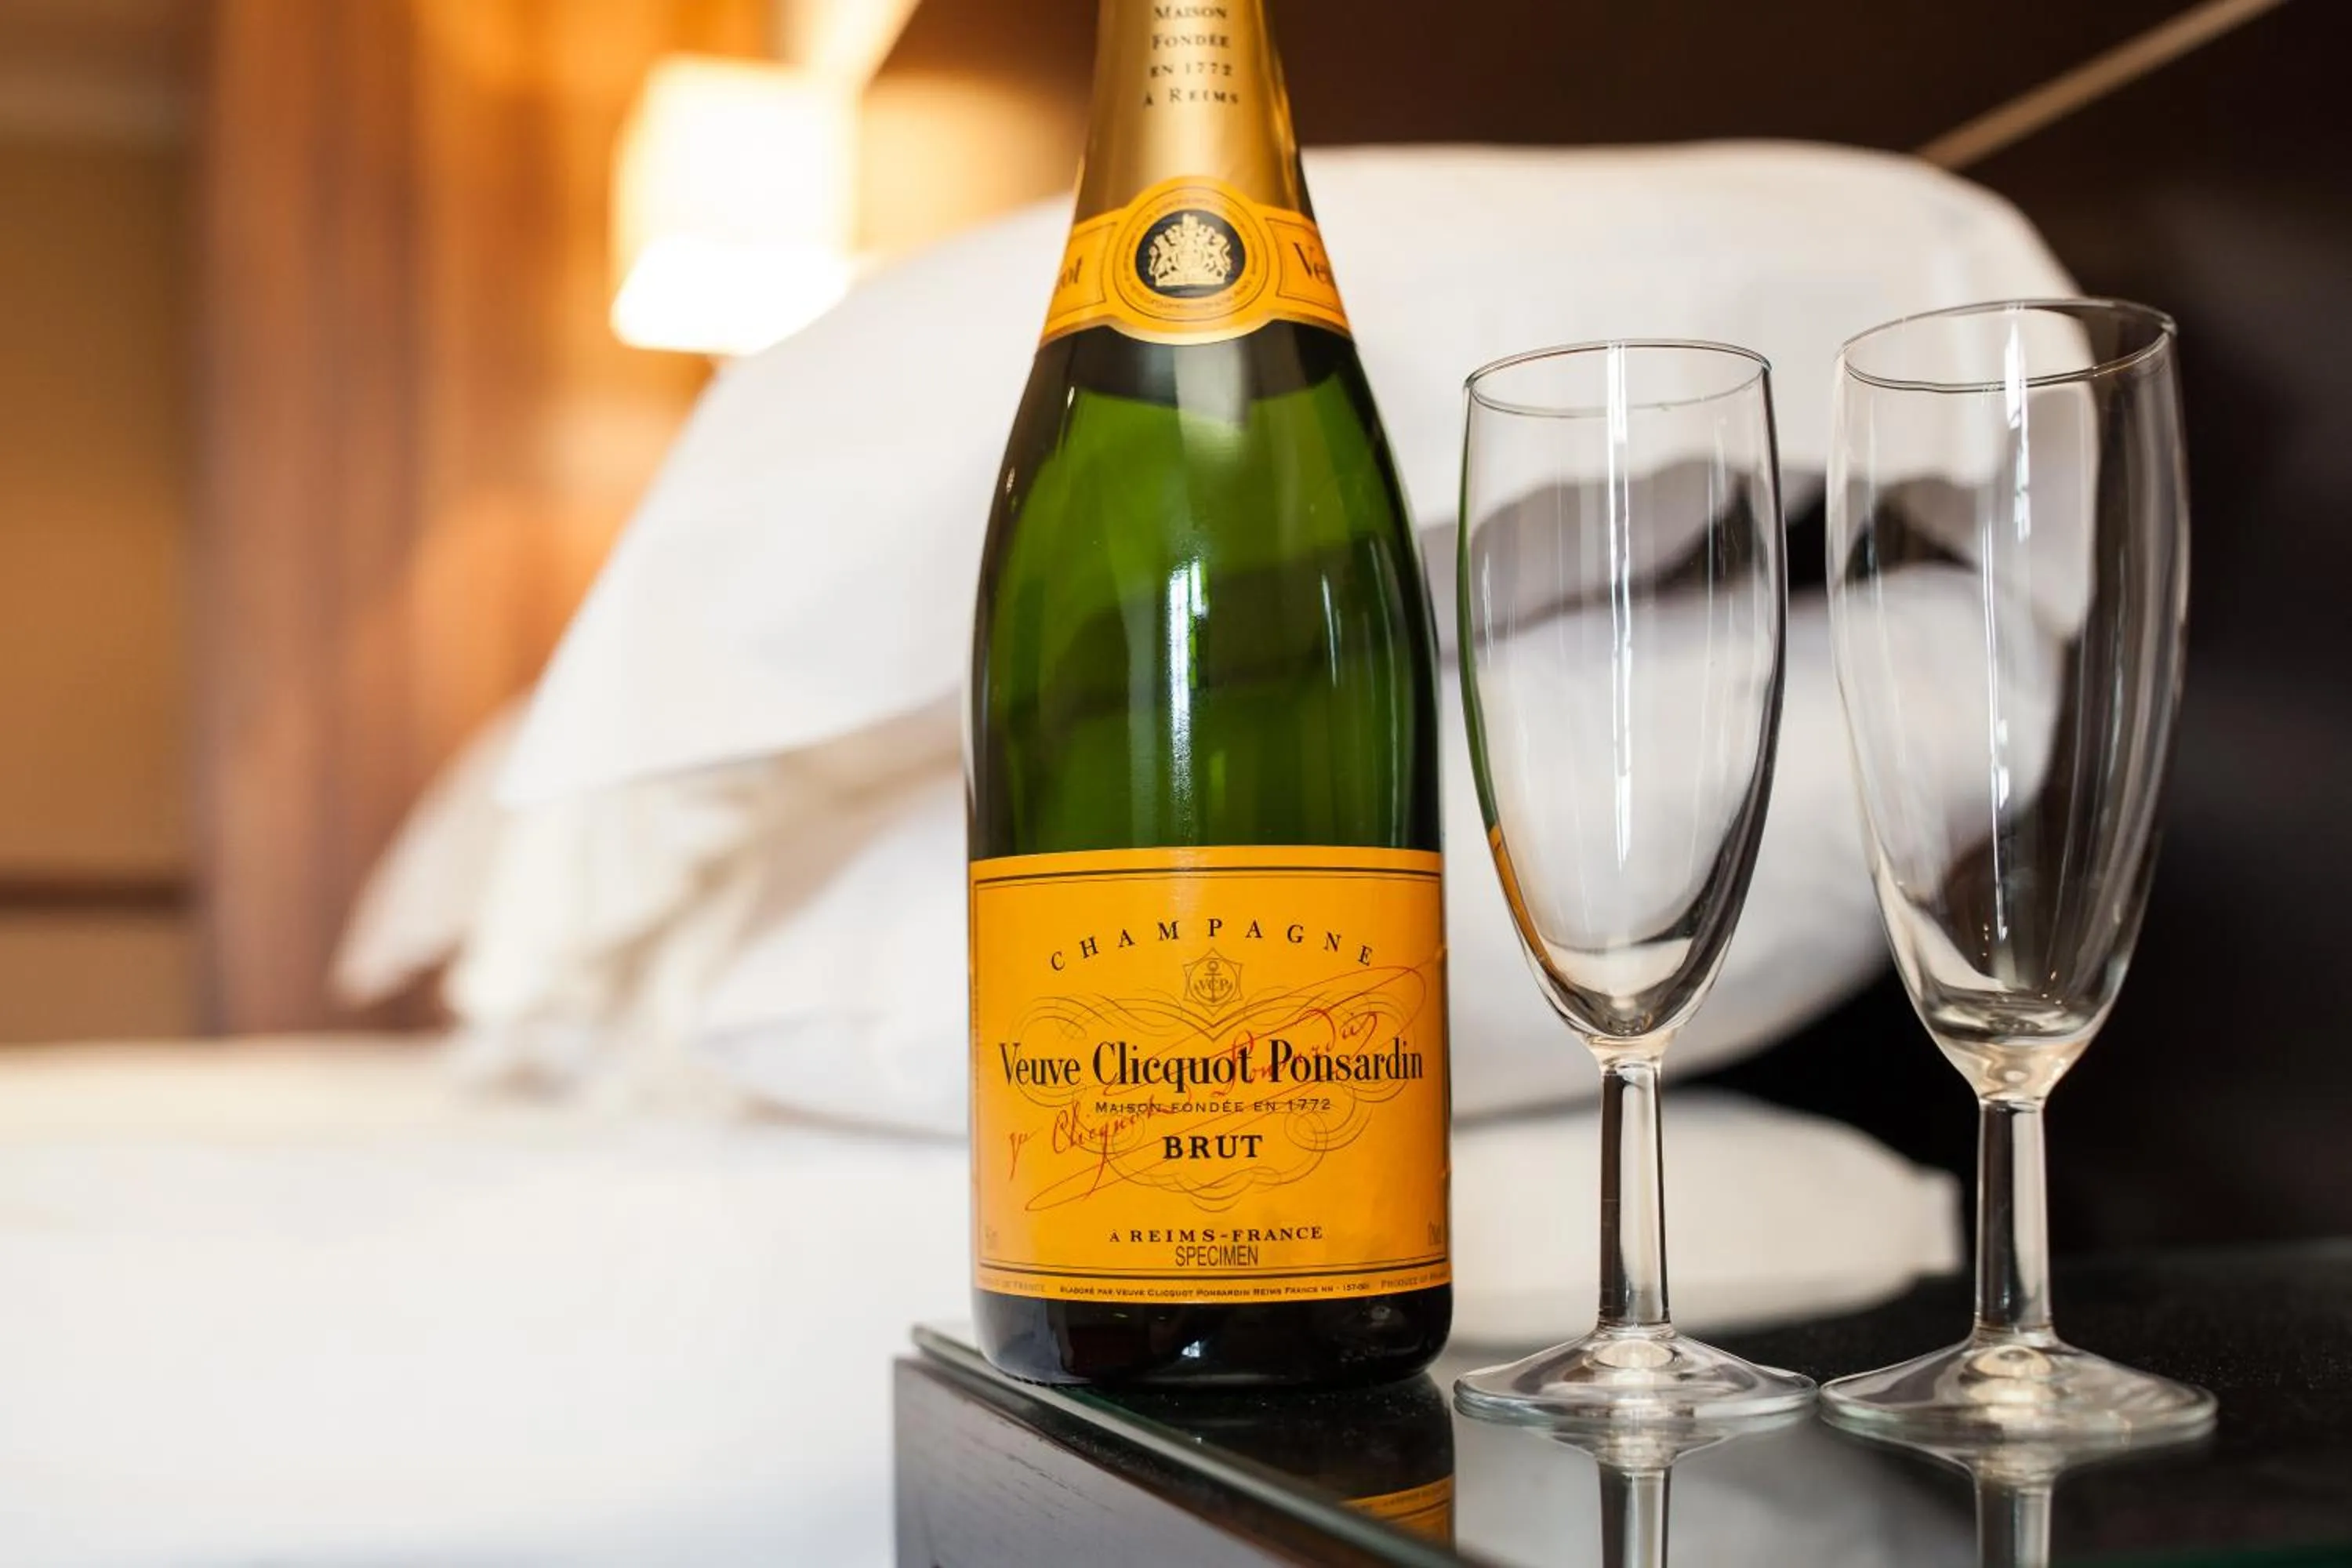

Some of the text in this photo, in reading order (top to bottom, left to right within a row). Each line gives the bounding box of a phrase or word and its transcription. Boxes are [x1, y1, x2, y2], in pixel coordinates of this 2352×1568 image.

[1185, 62, 1232, 76] 1772
[1169, 87, 1239, 104] REIMS
[1051, 918, 1372, 971] CHAMPAGNE
[998, 1037, 1423, 1093] Veuve Clicquot Ponsardin
[1095, 1098, 1330, 1112] MAISON FONDÉE EN 1772
[1163, 1135, 1263, 1159] BRUT
[1175, 1245, 1258, 1266] SPECIMEN
